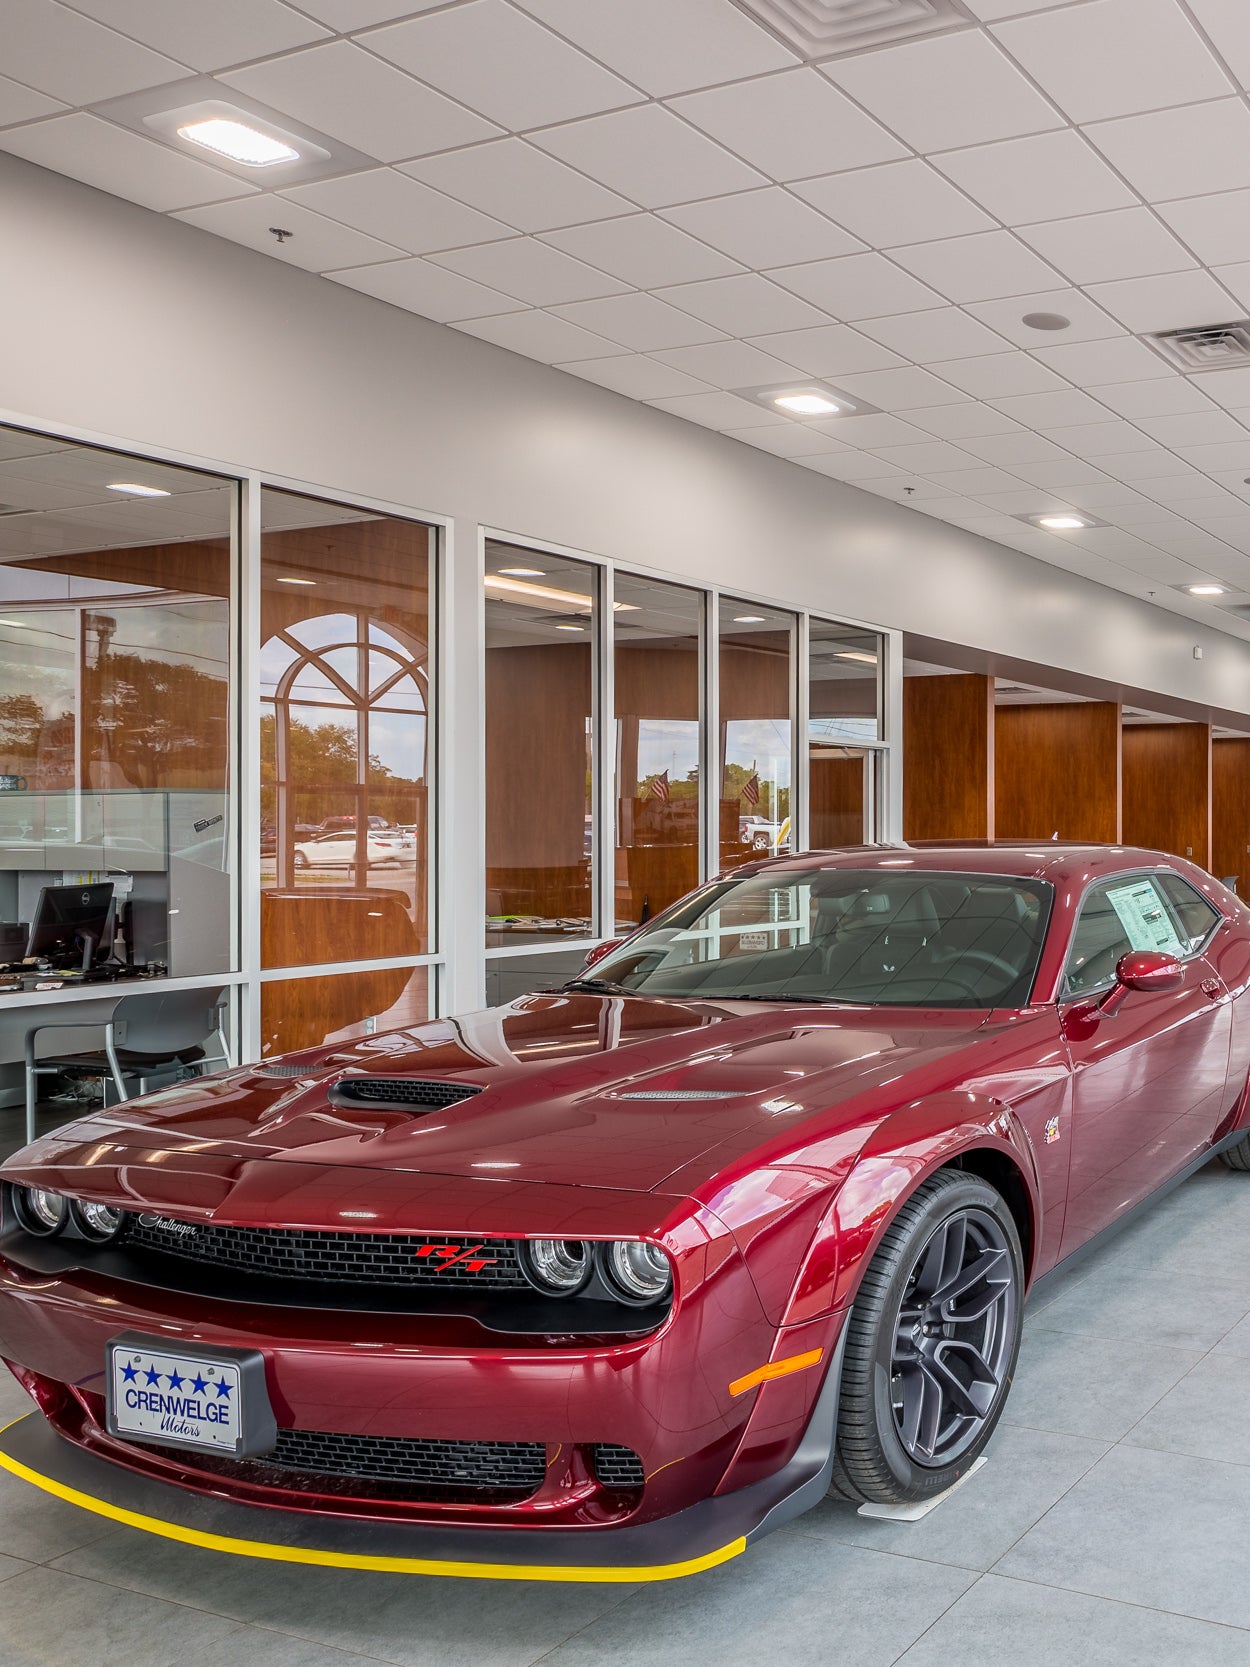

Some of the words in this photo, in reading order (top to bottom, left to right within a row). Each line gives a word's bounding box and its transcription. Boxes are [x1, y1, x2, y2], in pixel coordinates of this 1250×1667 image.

[138, 1212, 198, 1238] Challenger
[415, 1244, 498, 1272] R/T
[125, 1388, 230, 1426] CRENWELGE
[160, 1412, 201, 1437] Motors
